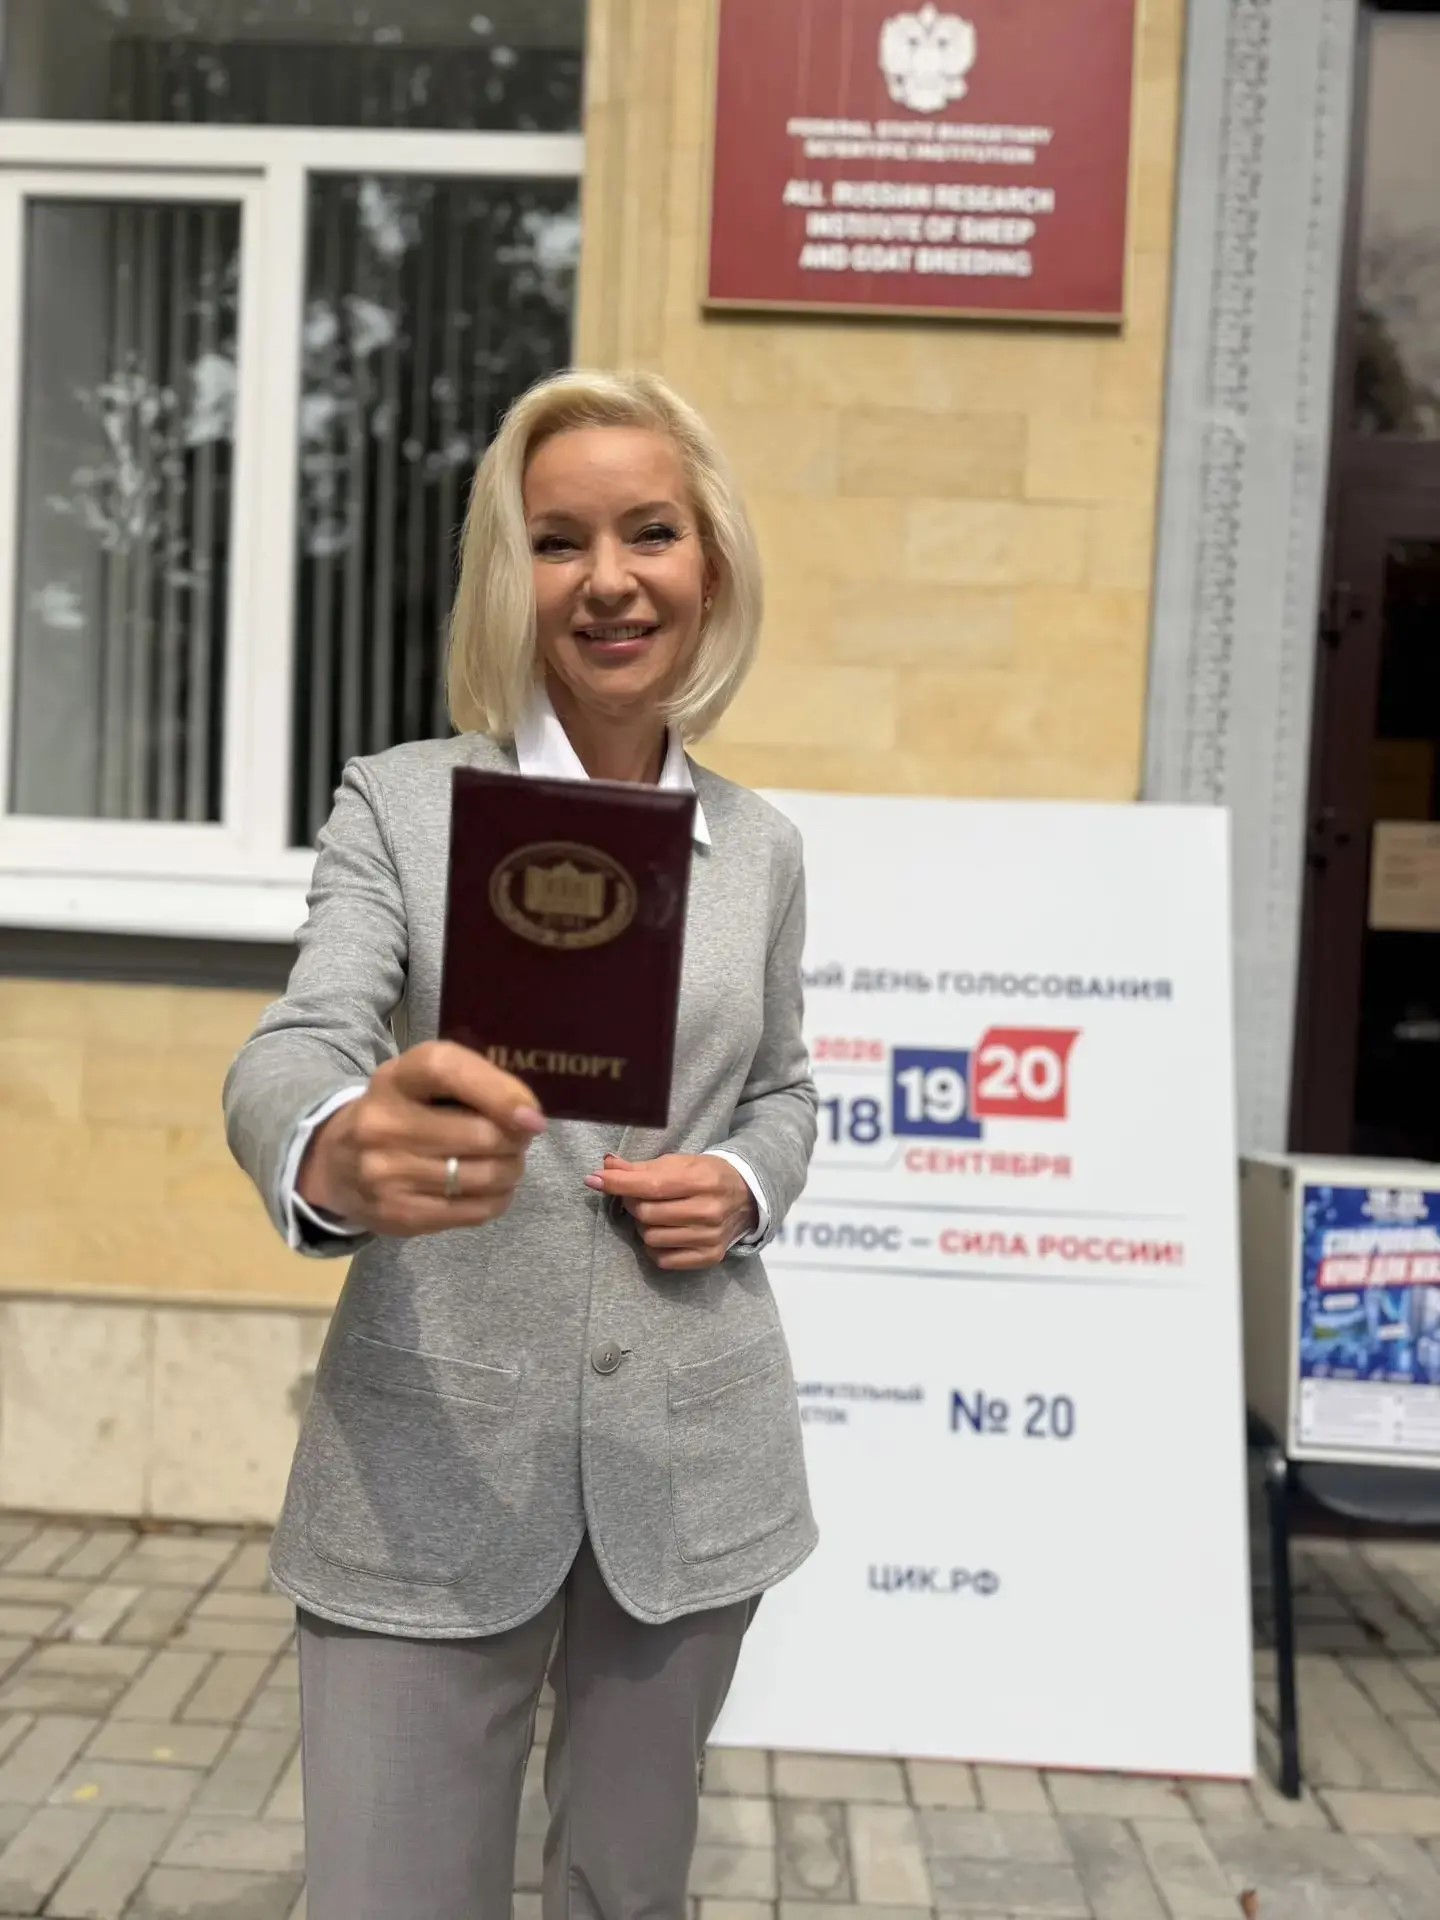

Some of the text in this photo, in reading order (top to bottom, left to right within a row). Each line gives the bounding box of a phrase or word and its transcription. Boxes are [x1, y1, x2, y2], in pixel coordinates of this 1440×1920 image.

[832, 181, 931, 209] RUSSIAN
[935, 184, 1055, 214] RESEARCH
[806, 212, 1036, 245] INSTITUTE OF SHEEP
[799, 243, 1032, 277] AND GOAT BREEDING
[801, 962, 1173, 1000] ЫЙ ДЕНЬ ГОЛОСОВАНИЯ
[822, 1046, 1062, 1145] 18 19 20
[904, 1147, 1072, 1179] СЕНТЯБРЯ
[797, 1221, 903, 1252] ГОЛОС
[939, 1229, 1029, 1258] СИЛА
[1039, 1235, 1185, 1267] РОССИИ!
[798, 1381, 924, 1403] ИРАТЕЛЬНЫЙ
[801, 1408, 848, 1426] СТОК
[949, 1389, 1076, 1439] № 20
[868, 1564, 1000, 1596] ЦИК.РФ
